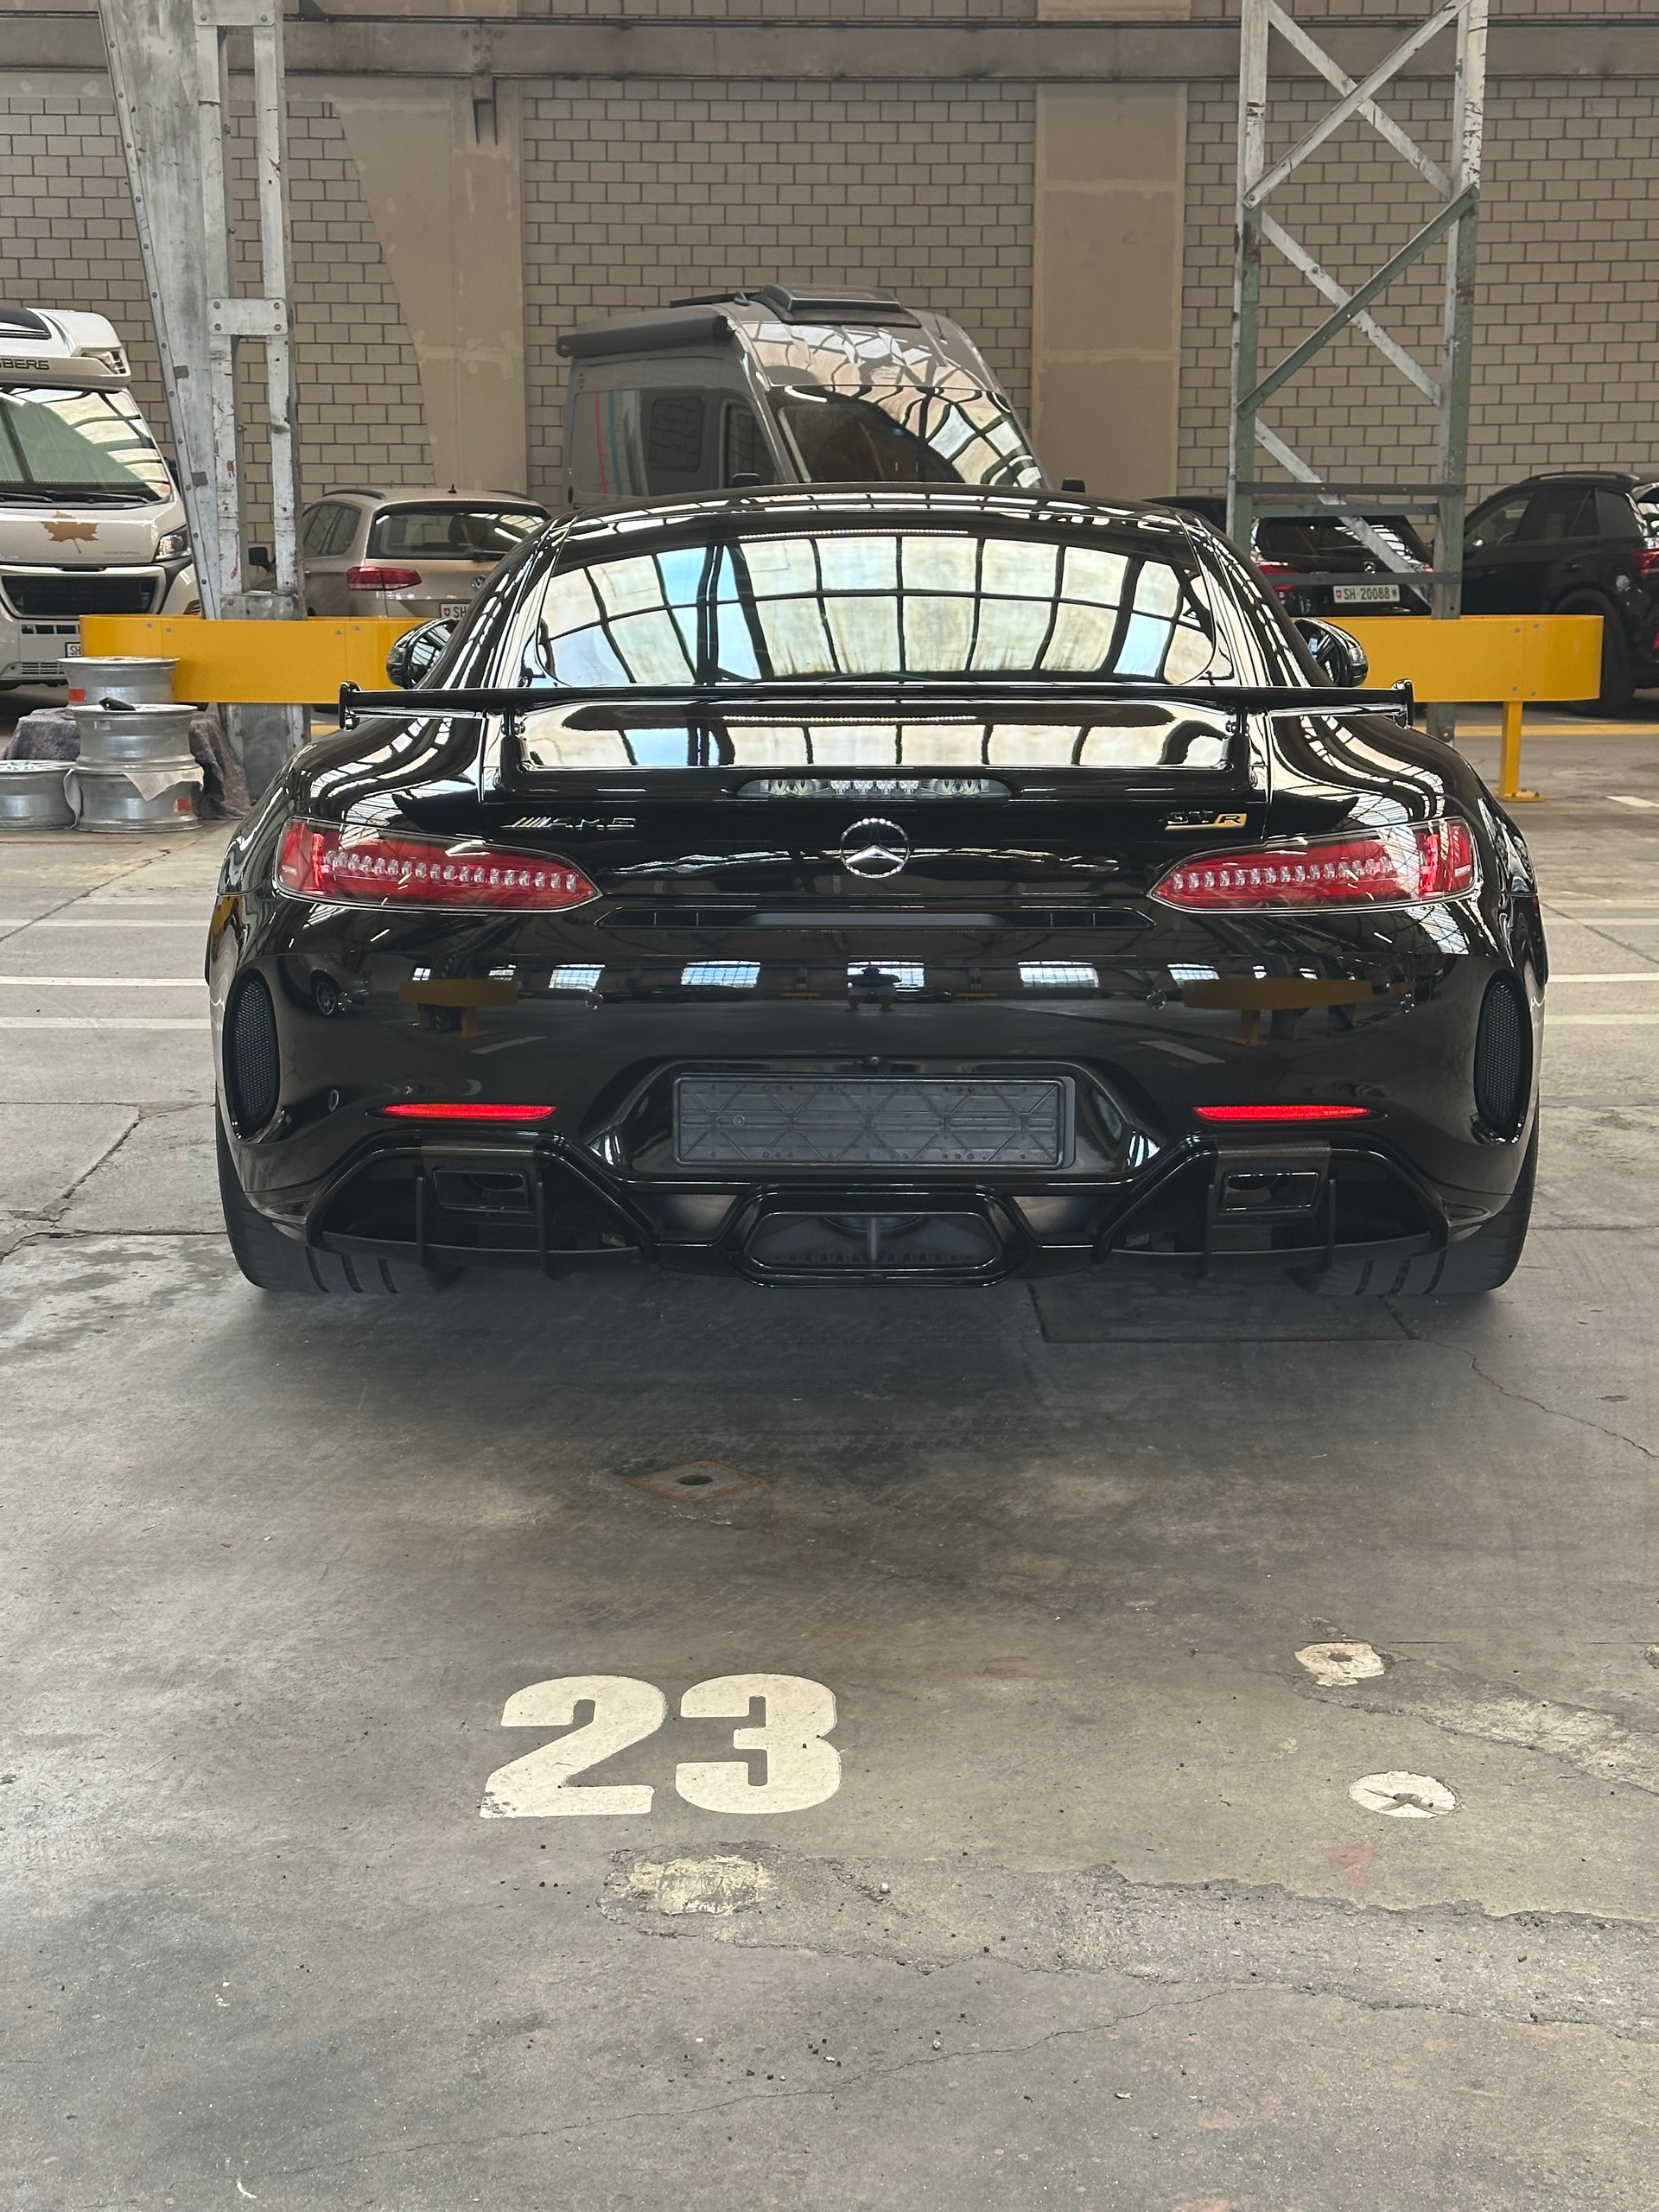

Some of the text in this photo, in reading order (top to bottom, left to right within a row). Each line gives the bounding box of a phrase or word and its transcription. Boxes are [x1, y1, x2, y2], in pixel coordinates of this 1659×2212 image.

[0, 359, 49, 370] BERG
[1344, 588, 1389, 600] SH 20088
[69, 645, 81, 656] SH
[479, 1673, 842, 1819] 23
